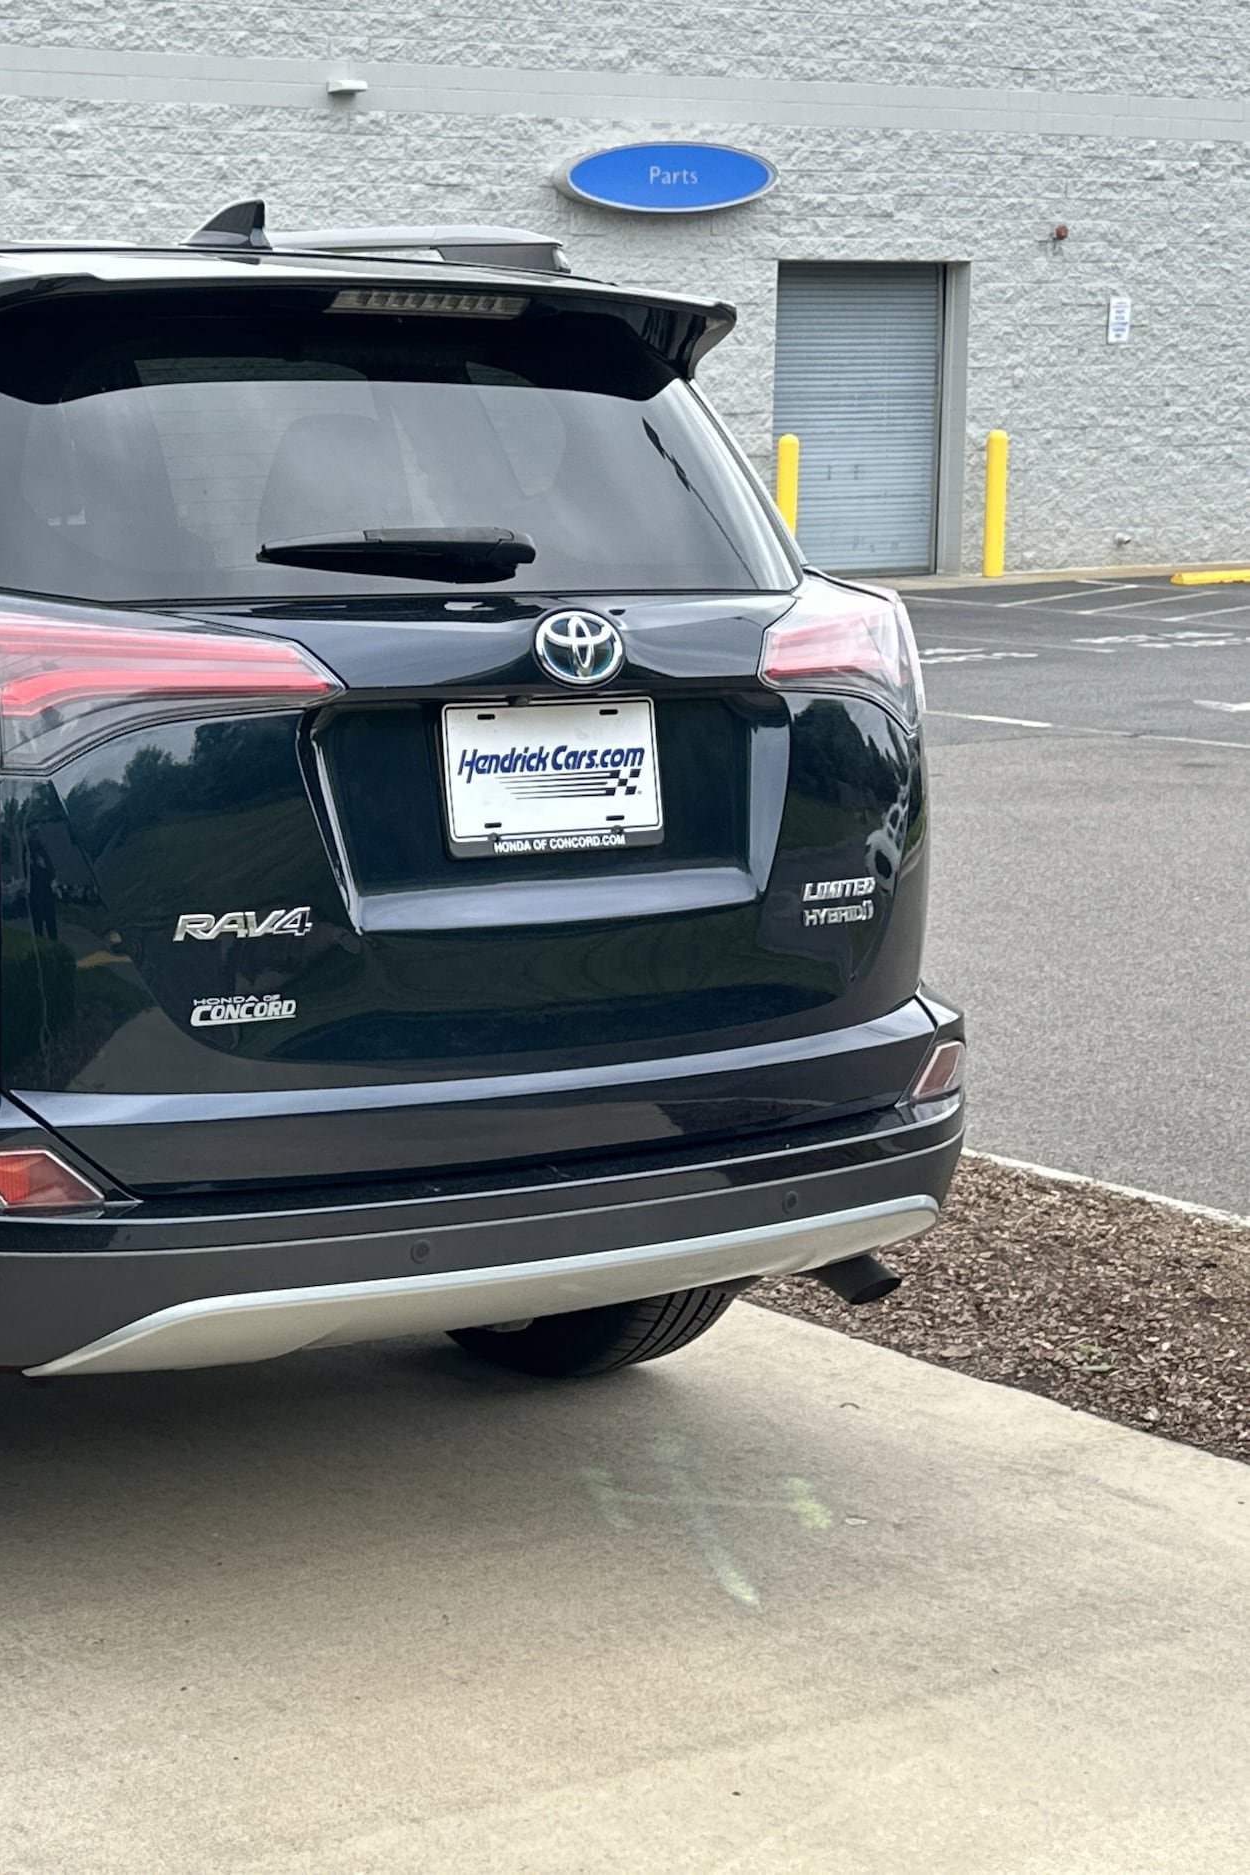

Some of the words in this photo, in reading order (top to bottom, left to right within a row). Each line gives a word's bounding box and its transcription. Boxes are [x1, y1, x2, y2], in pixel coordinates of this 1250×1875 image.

[649, 166, 698, 185] Parts
[493, 841, 531, 853] HONDA
[533, 839, 547, 850] OF
[550, 834, 626, 849] CONCORD.COM
[173, 906, 313, 942] RAV4
[193, 995, 259, 1006] HONDA
[262, 994, 281, 1002] OF
[190, 1000, 297, 1027] CONCORD
